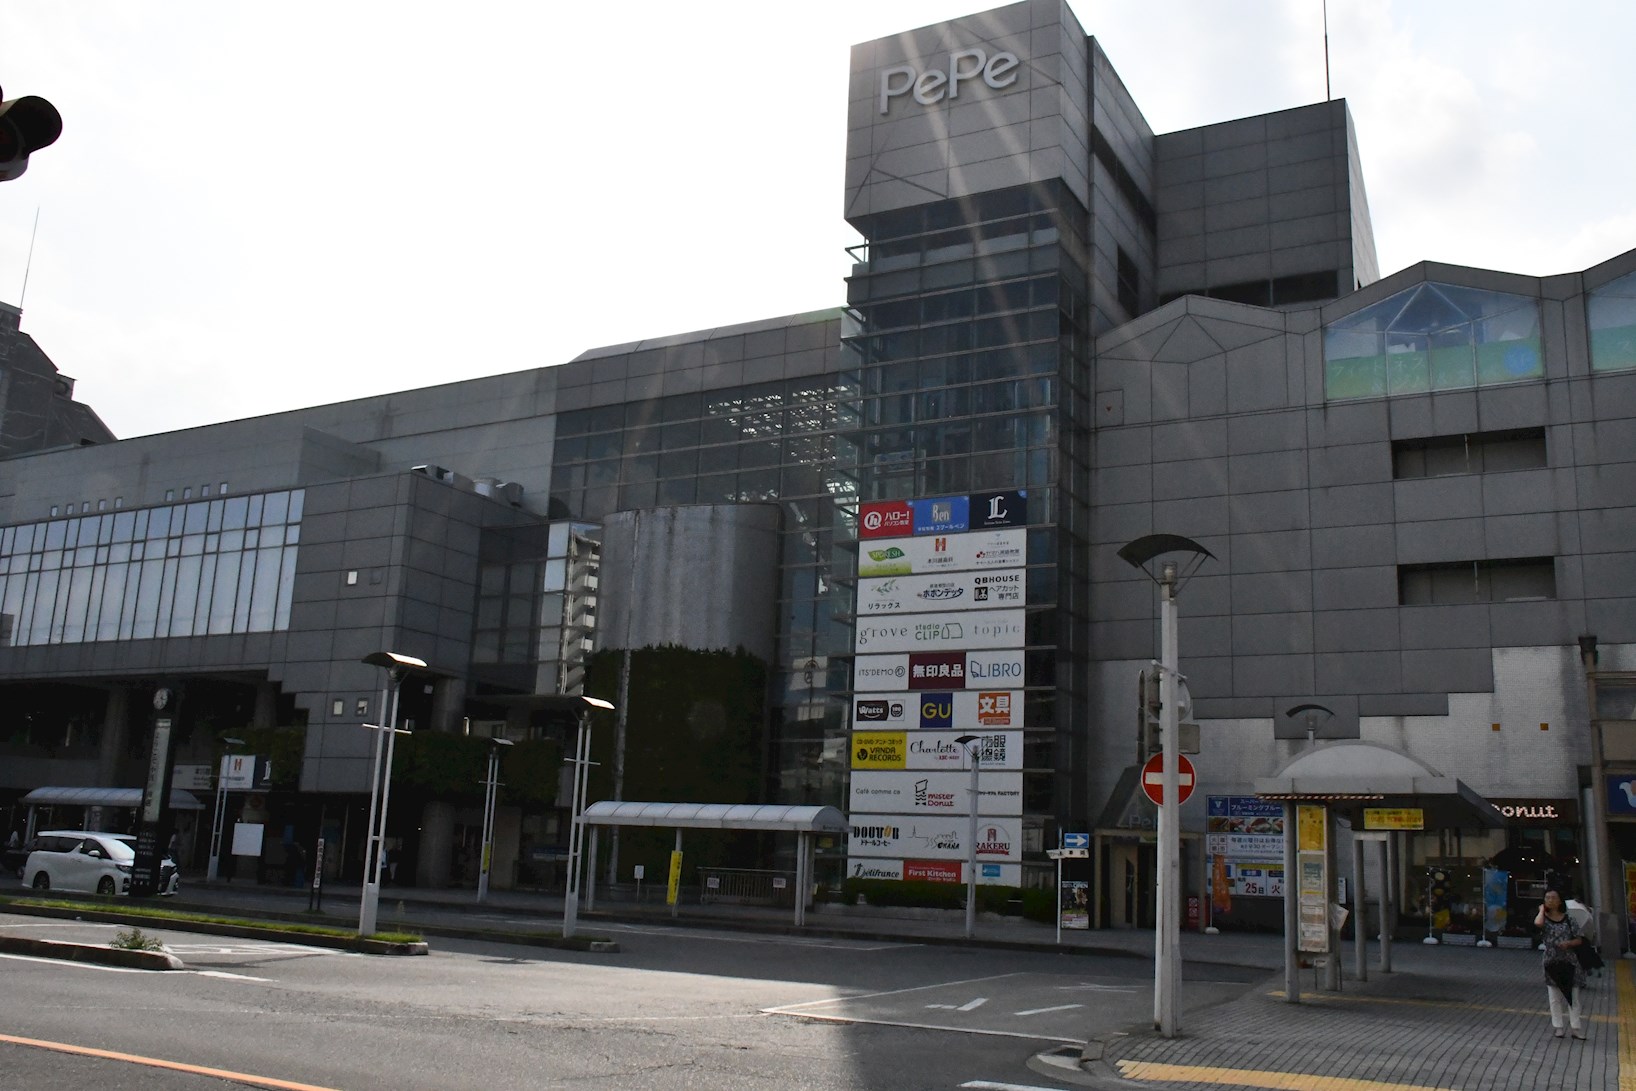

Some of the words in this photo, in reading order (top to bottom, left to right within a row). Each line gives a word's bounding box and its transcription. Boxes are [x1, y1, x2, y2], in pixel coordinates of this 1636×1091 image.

[880, 48, 1020, 115] PePe
[998, 592, 1019, 600] 専門店
[915, 623, 940, 631] studio
[975, 624, 1020, 638] topic
[860, 627, 908, 645] grove
[915, 630, 940, 641] CLIP
[912, 663, 964, 678] 無印良品
[980, 662, 1022, 678] LIBRO
[922, 702, 951, 719] GU
[979, 695, 1010, 714] 文具
[869, 746, 896, 754] VANDA
[910, 740, 957, 754] Charlotte
[868, 754, 902, 762] RECORDS
[908, 869, 926, 877] First
[927, 870, 957, 878] Kitchen
